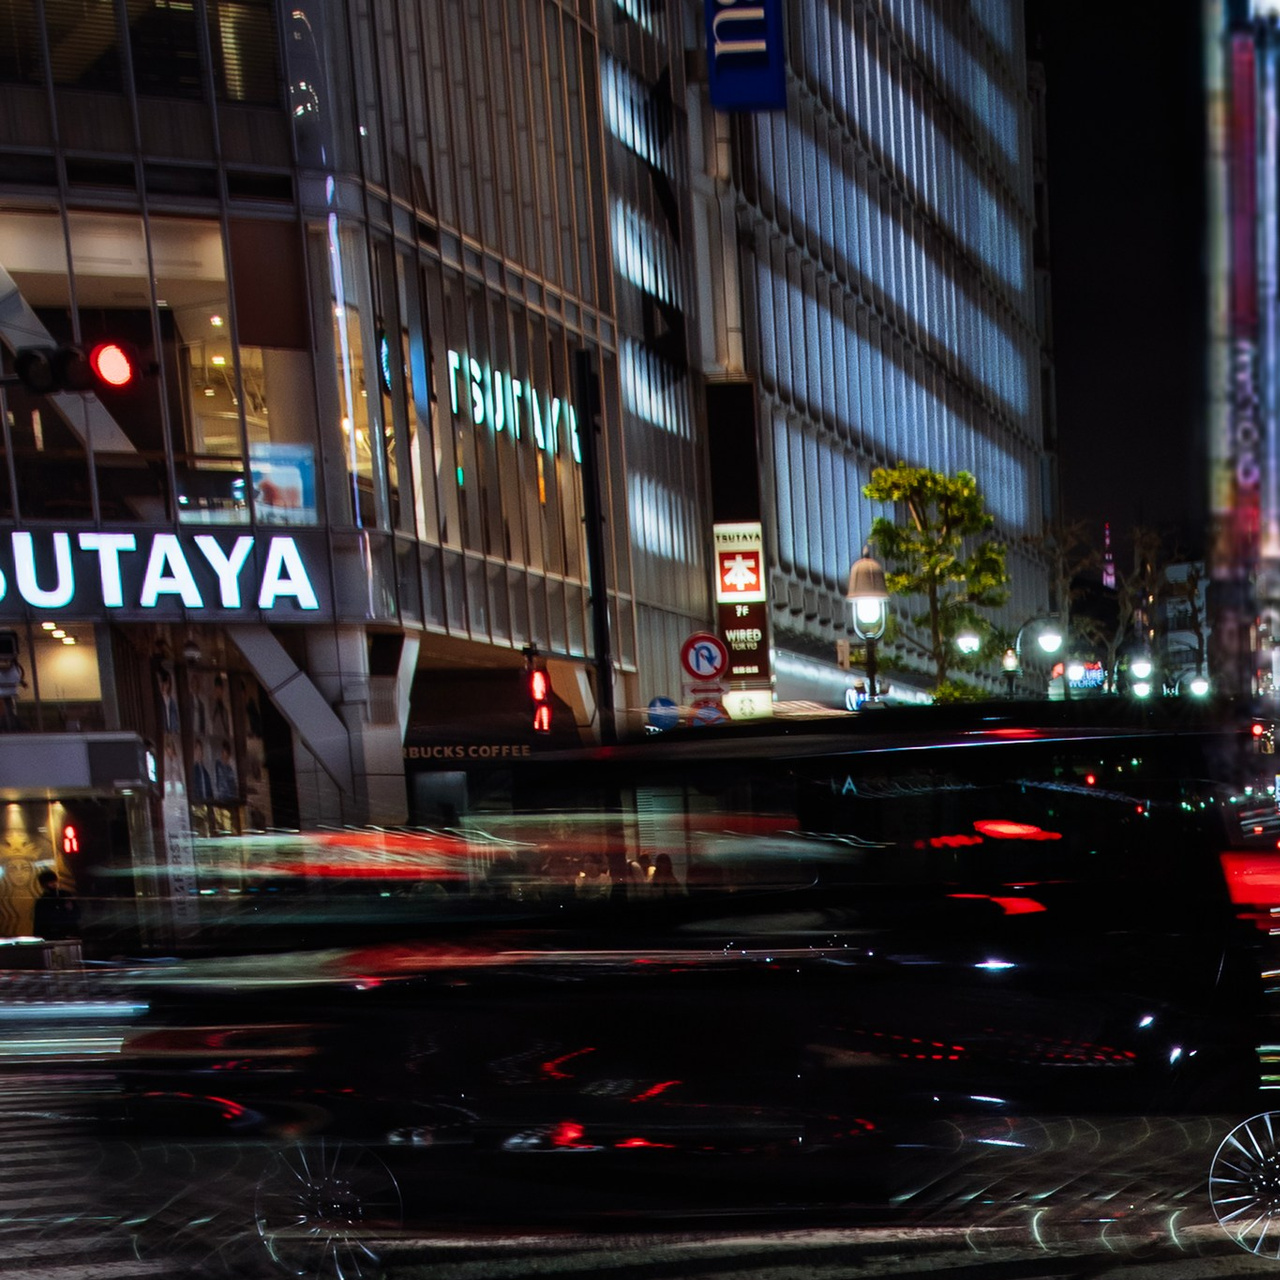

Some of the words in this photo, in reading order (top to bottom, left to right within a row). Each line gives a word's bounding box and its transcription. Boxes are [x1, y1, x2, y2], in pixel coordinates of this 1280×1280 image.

[713, 0, 767, 58] u
[716, 534, 760, 543] TSUTAYA
[0, 531, 319, 609] UTAYA
[723, 554, 757, 590] 本
[725, 629, 761, 642] WIRED
[468, 745, 531, 758] COFFEE
